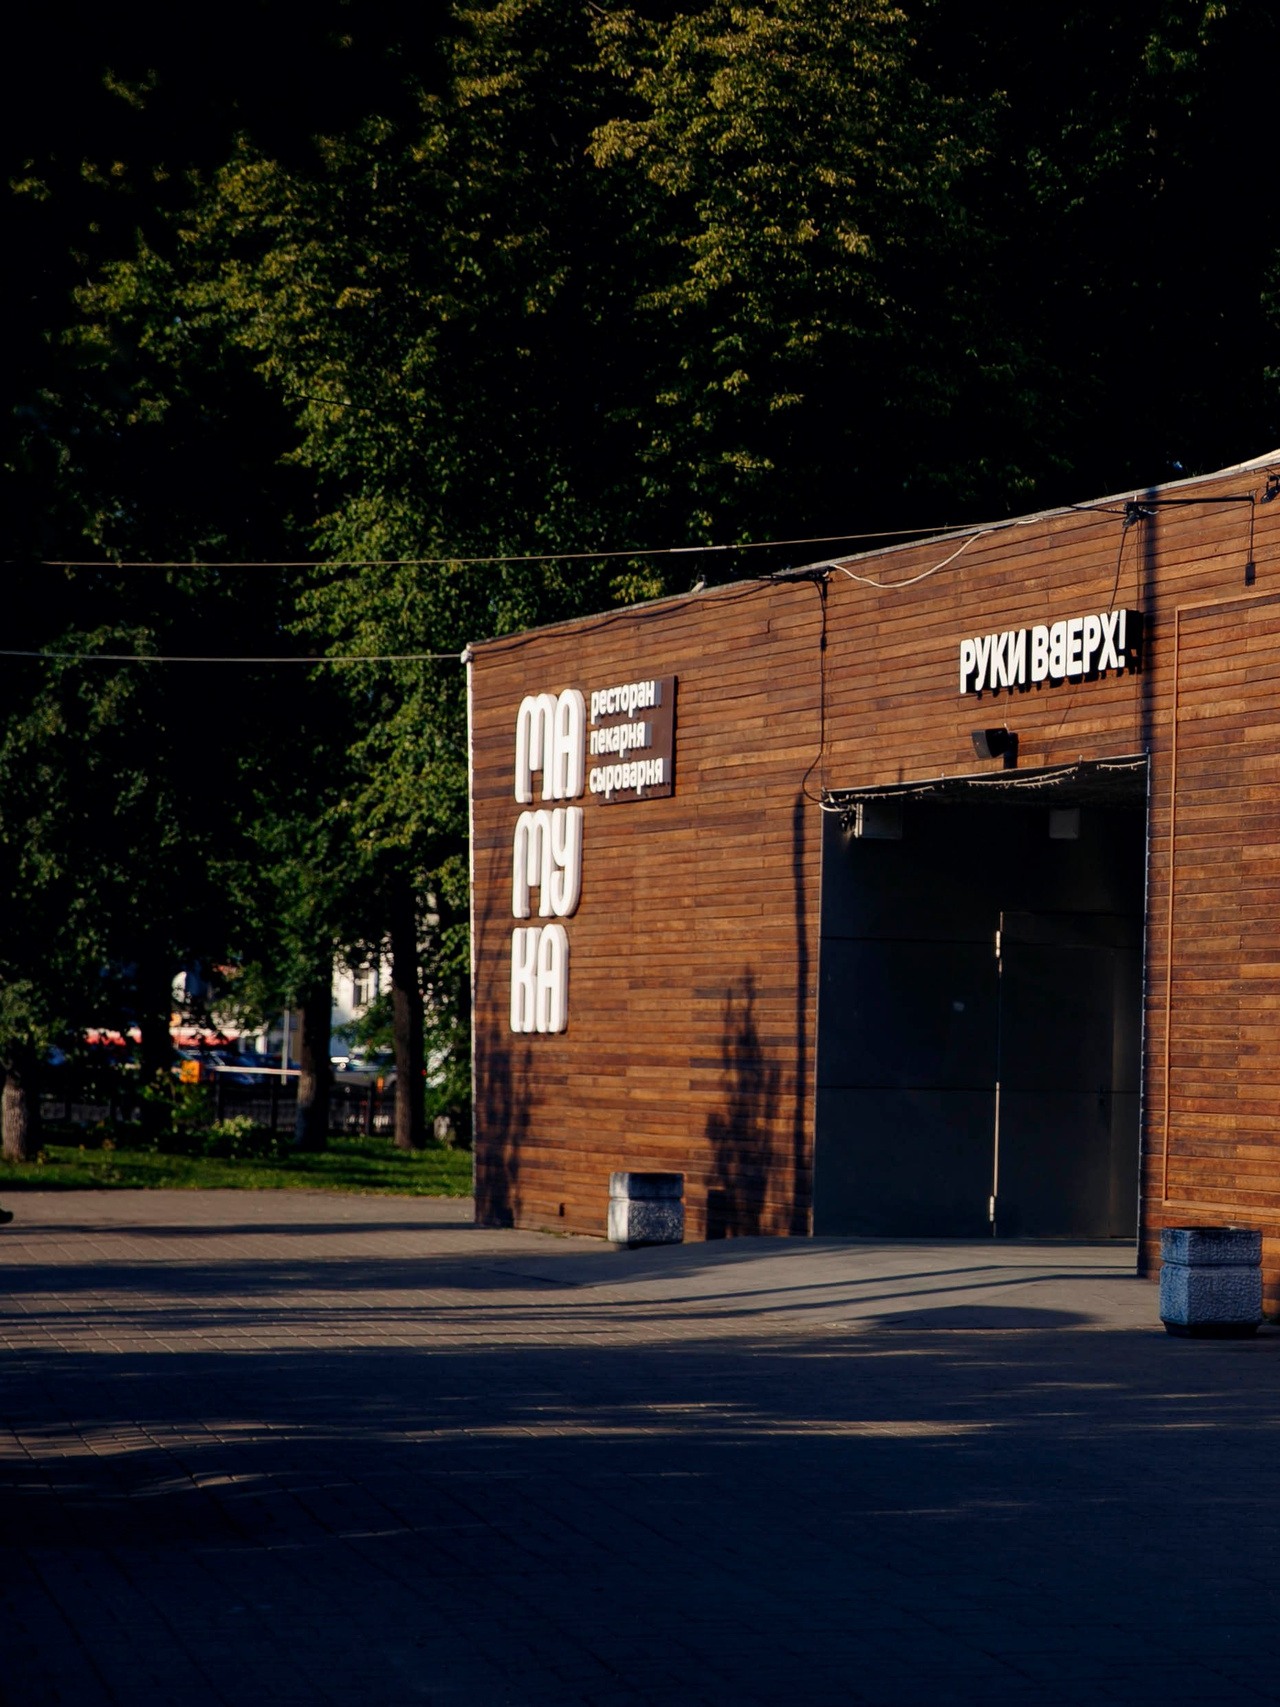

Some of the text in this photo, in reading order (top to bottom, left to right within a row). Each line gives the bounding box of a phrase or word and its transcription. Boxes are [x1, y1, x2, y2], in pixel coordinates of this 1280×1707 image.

[960, 609, 1127, 694] РУКИ ВВЕРХ!
[590, 721, 646, 758] пекарня
[591, 680, 656, 725] ресторан
[515, 688, 587, 804] МА
[589, 757, 664, 799] сыроварня
[512, 805, 584, 918] МУ
[510, 922, 569, 1033] КА
